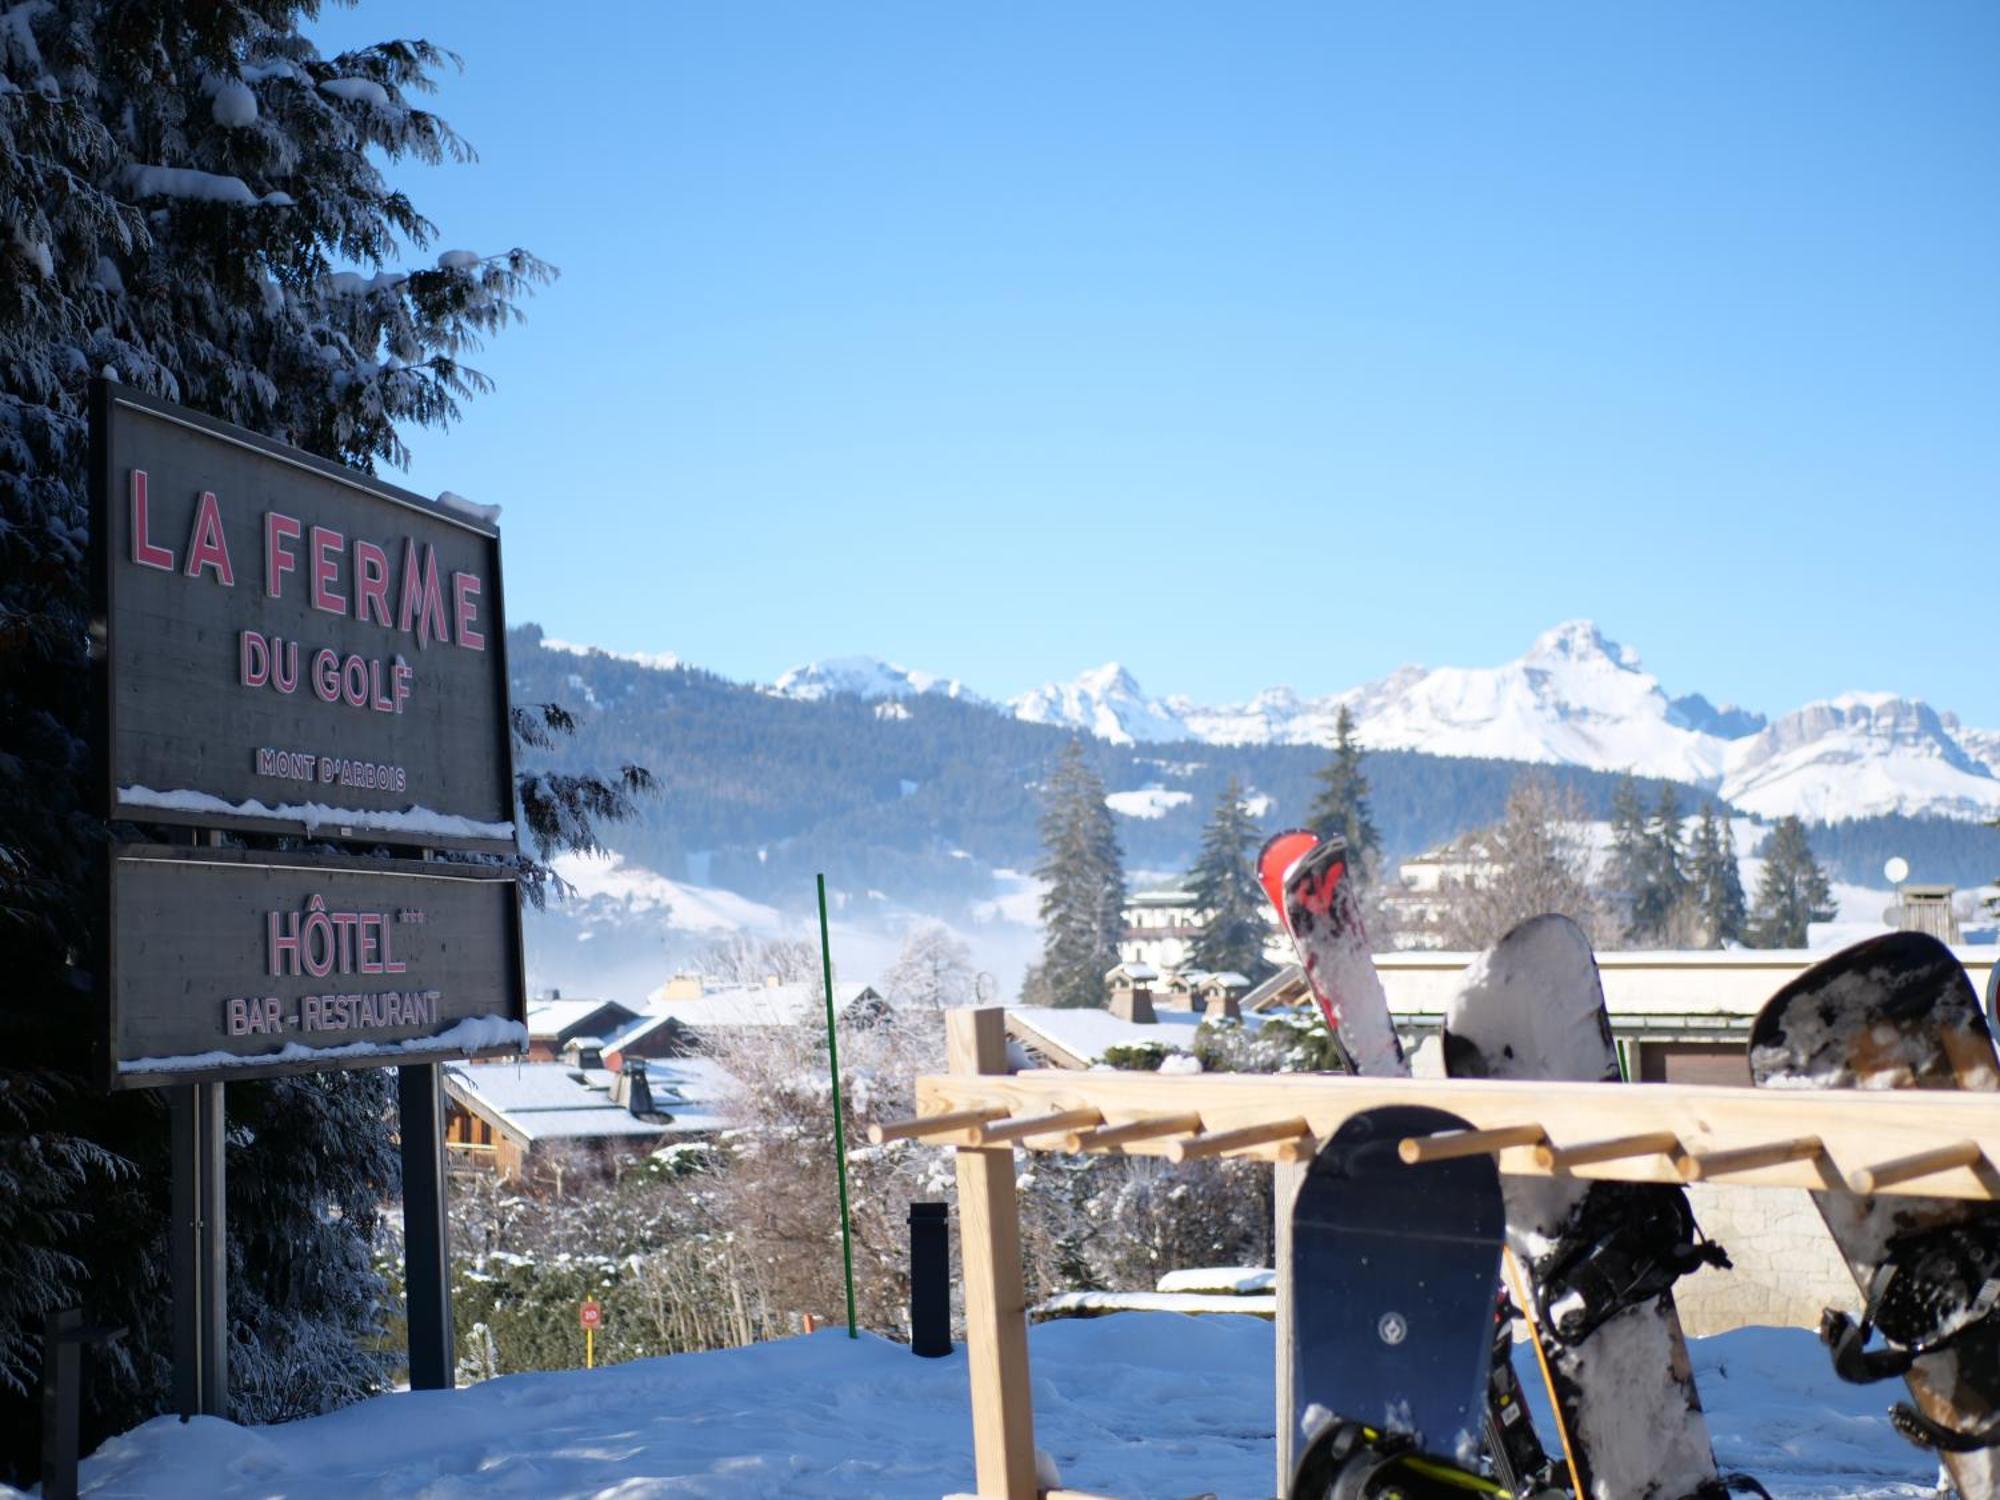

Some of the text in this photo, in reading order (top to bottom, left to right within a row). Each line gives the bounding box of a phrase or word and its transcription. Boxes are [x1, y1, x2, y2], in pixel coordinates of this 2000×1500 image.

[130, 469, 485, 651] LA FERME
[240, 631, 413, 714] DU GOLF
[256, 747, 407, 792] MONT D'ARBOIS
[267, 893, 407, 978] HÔTEL
[226, 997, 283, 1036] BAR
[300, 990, 440, 1032] RESTAURANT
